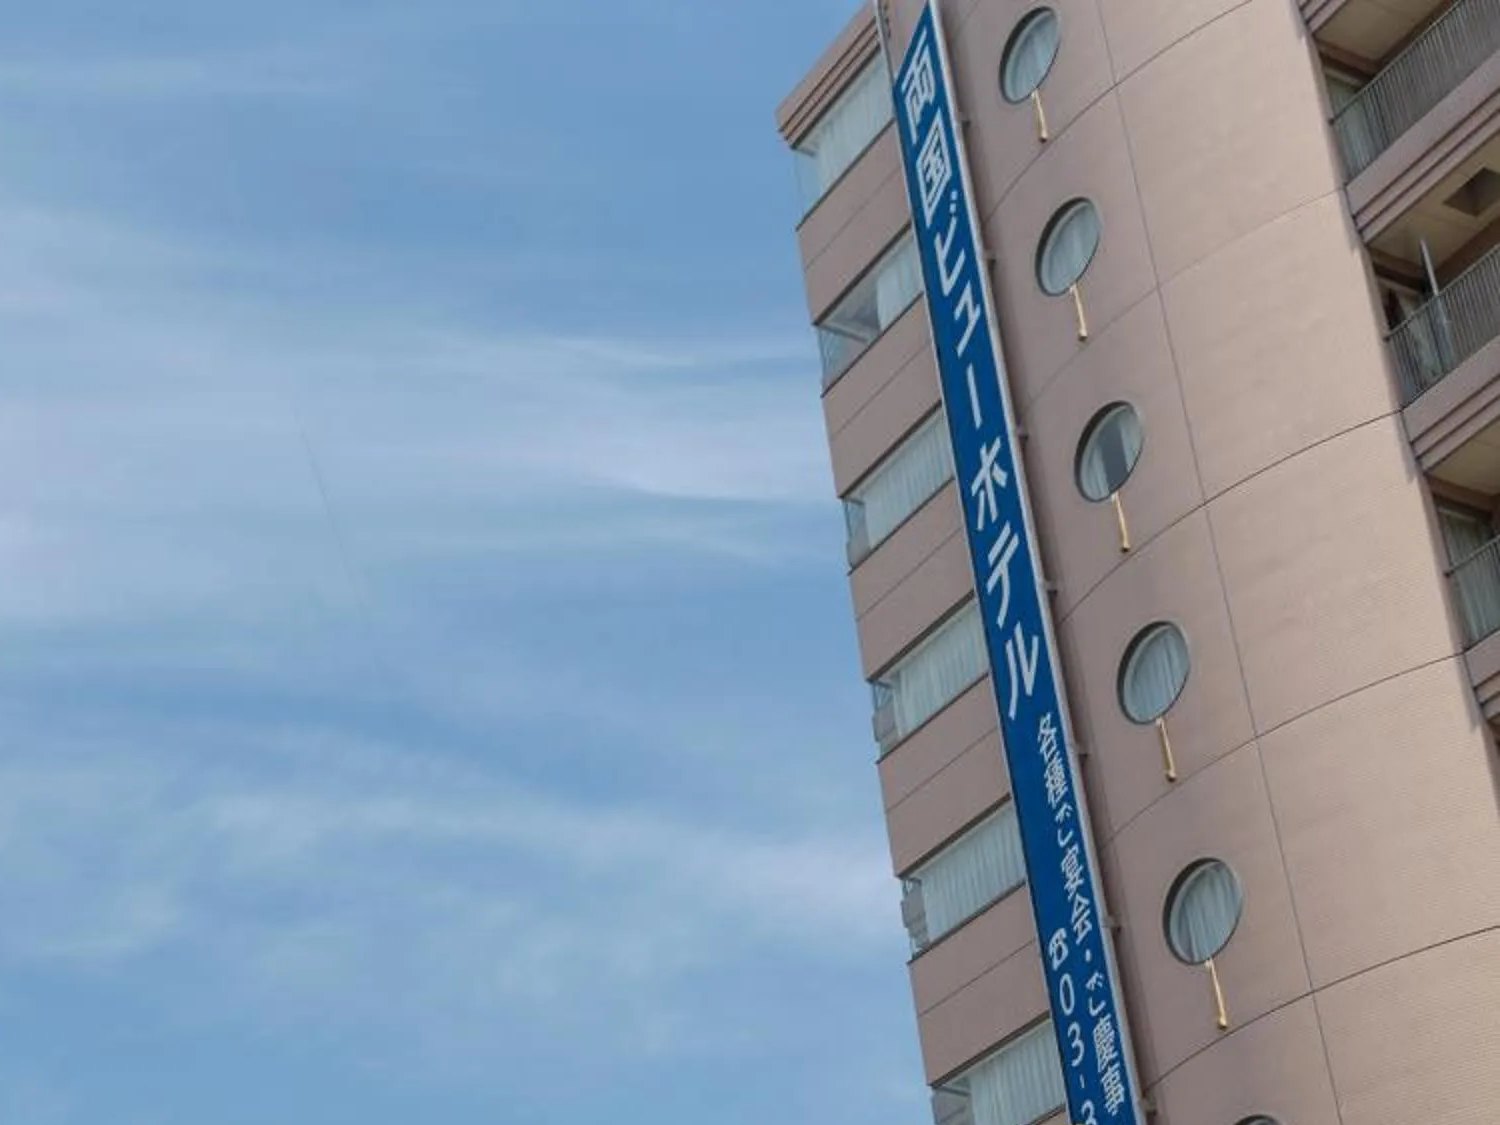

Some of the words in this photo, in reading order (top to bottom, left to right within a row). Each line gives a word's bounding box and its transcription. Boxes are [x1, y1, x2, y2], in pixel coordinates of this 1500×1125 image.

[901, 26, 1040, 721] 両国ビューホテル
